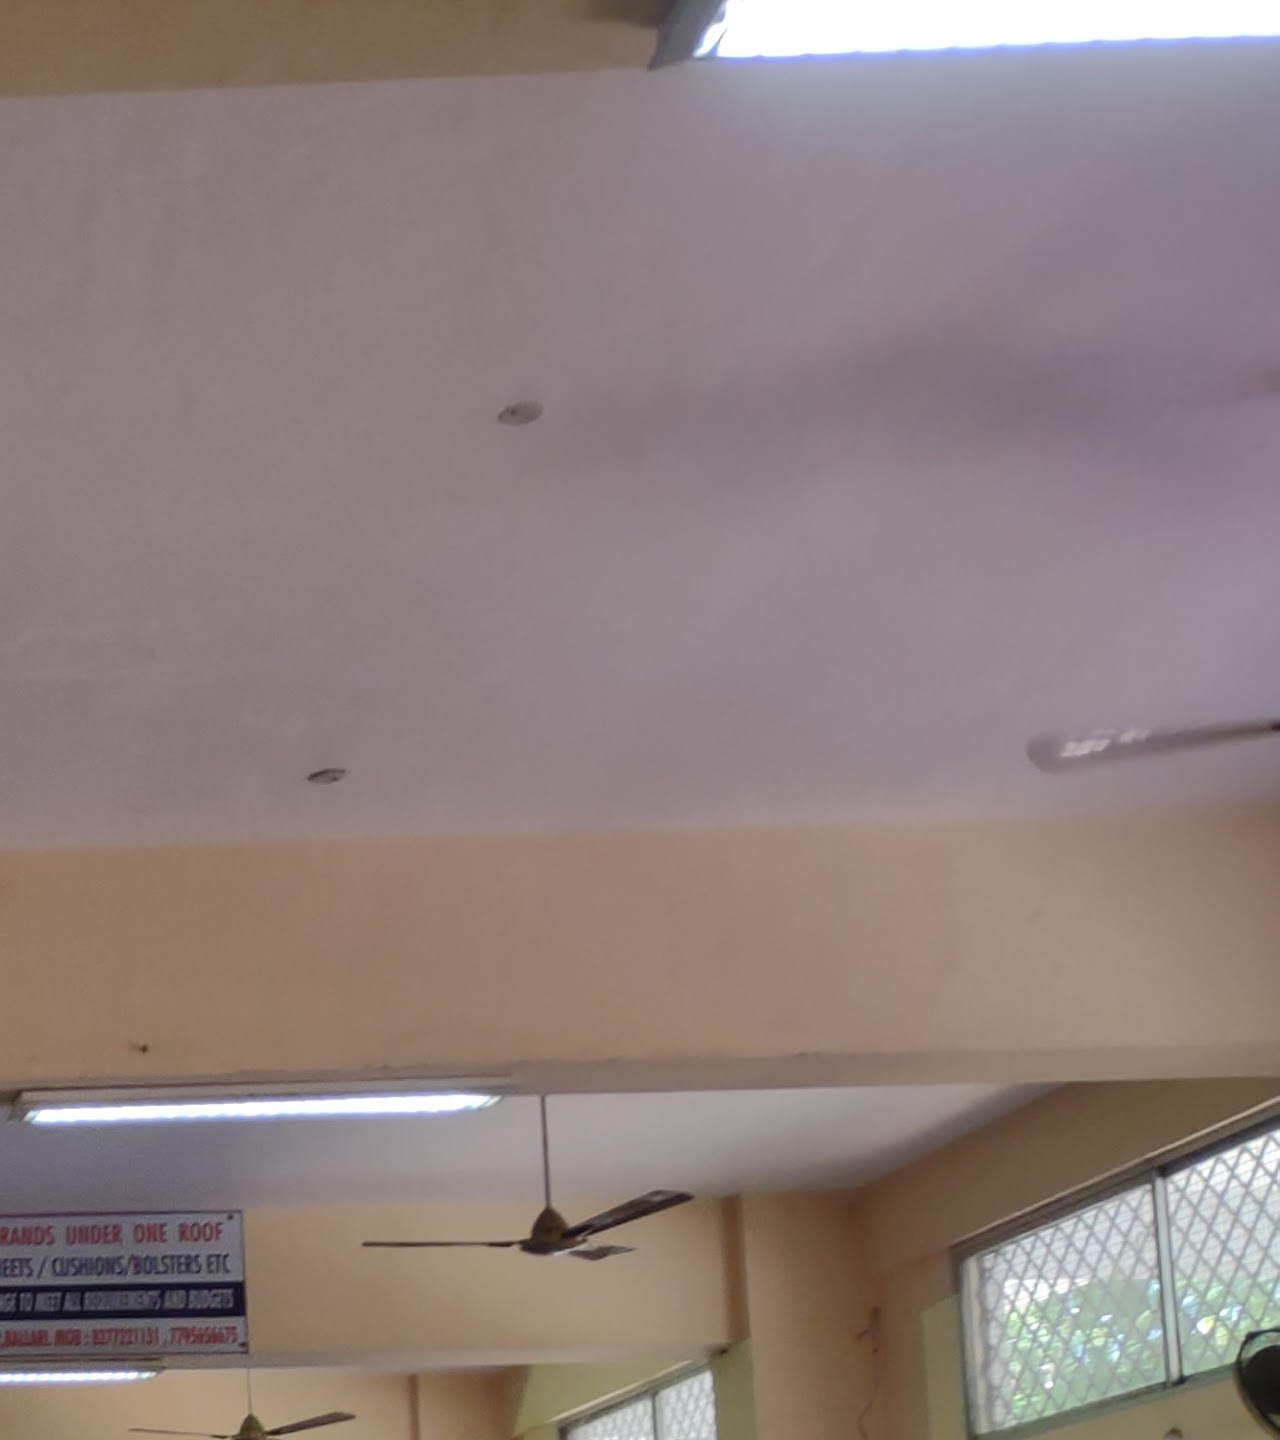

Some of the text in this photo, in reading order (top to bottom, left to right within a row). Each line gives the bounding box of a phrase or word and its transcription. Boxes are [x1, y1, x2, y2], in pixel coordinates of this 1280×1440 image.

[65, 1223, 123, 1245] UNDER
[133, 1222, 167, 1244] ONE
[177, 1221, 224, 1243] ROOF
[206, 1253, 231, 1274] ETC
